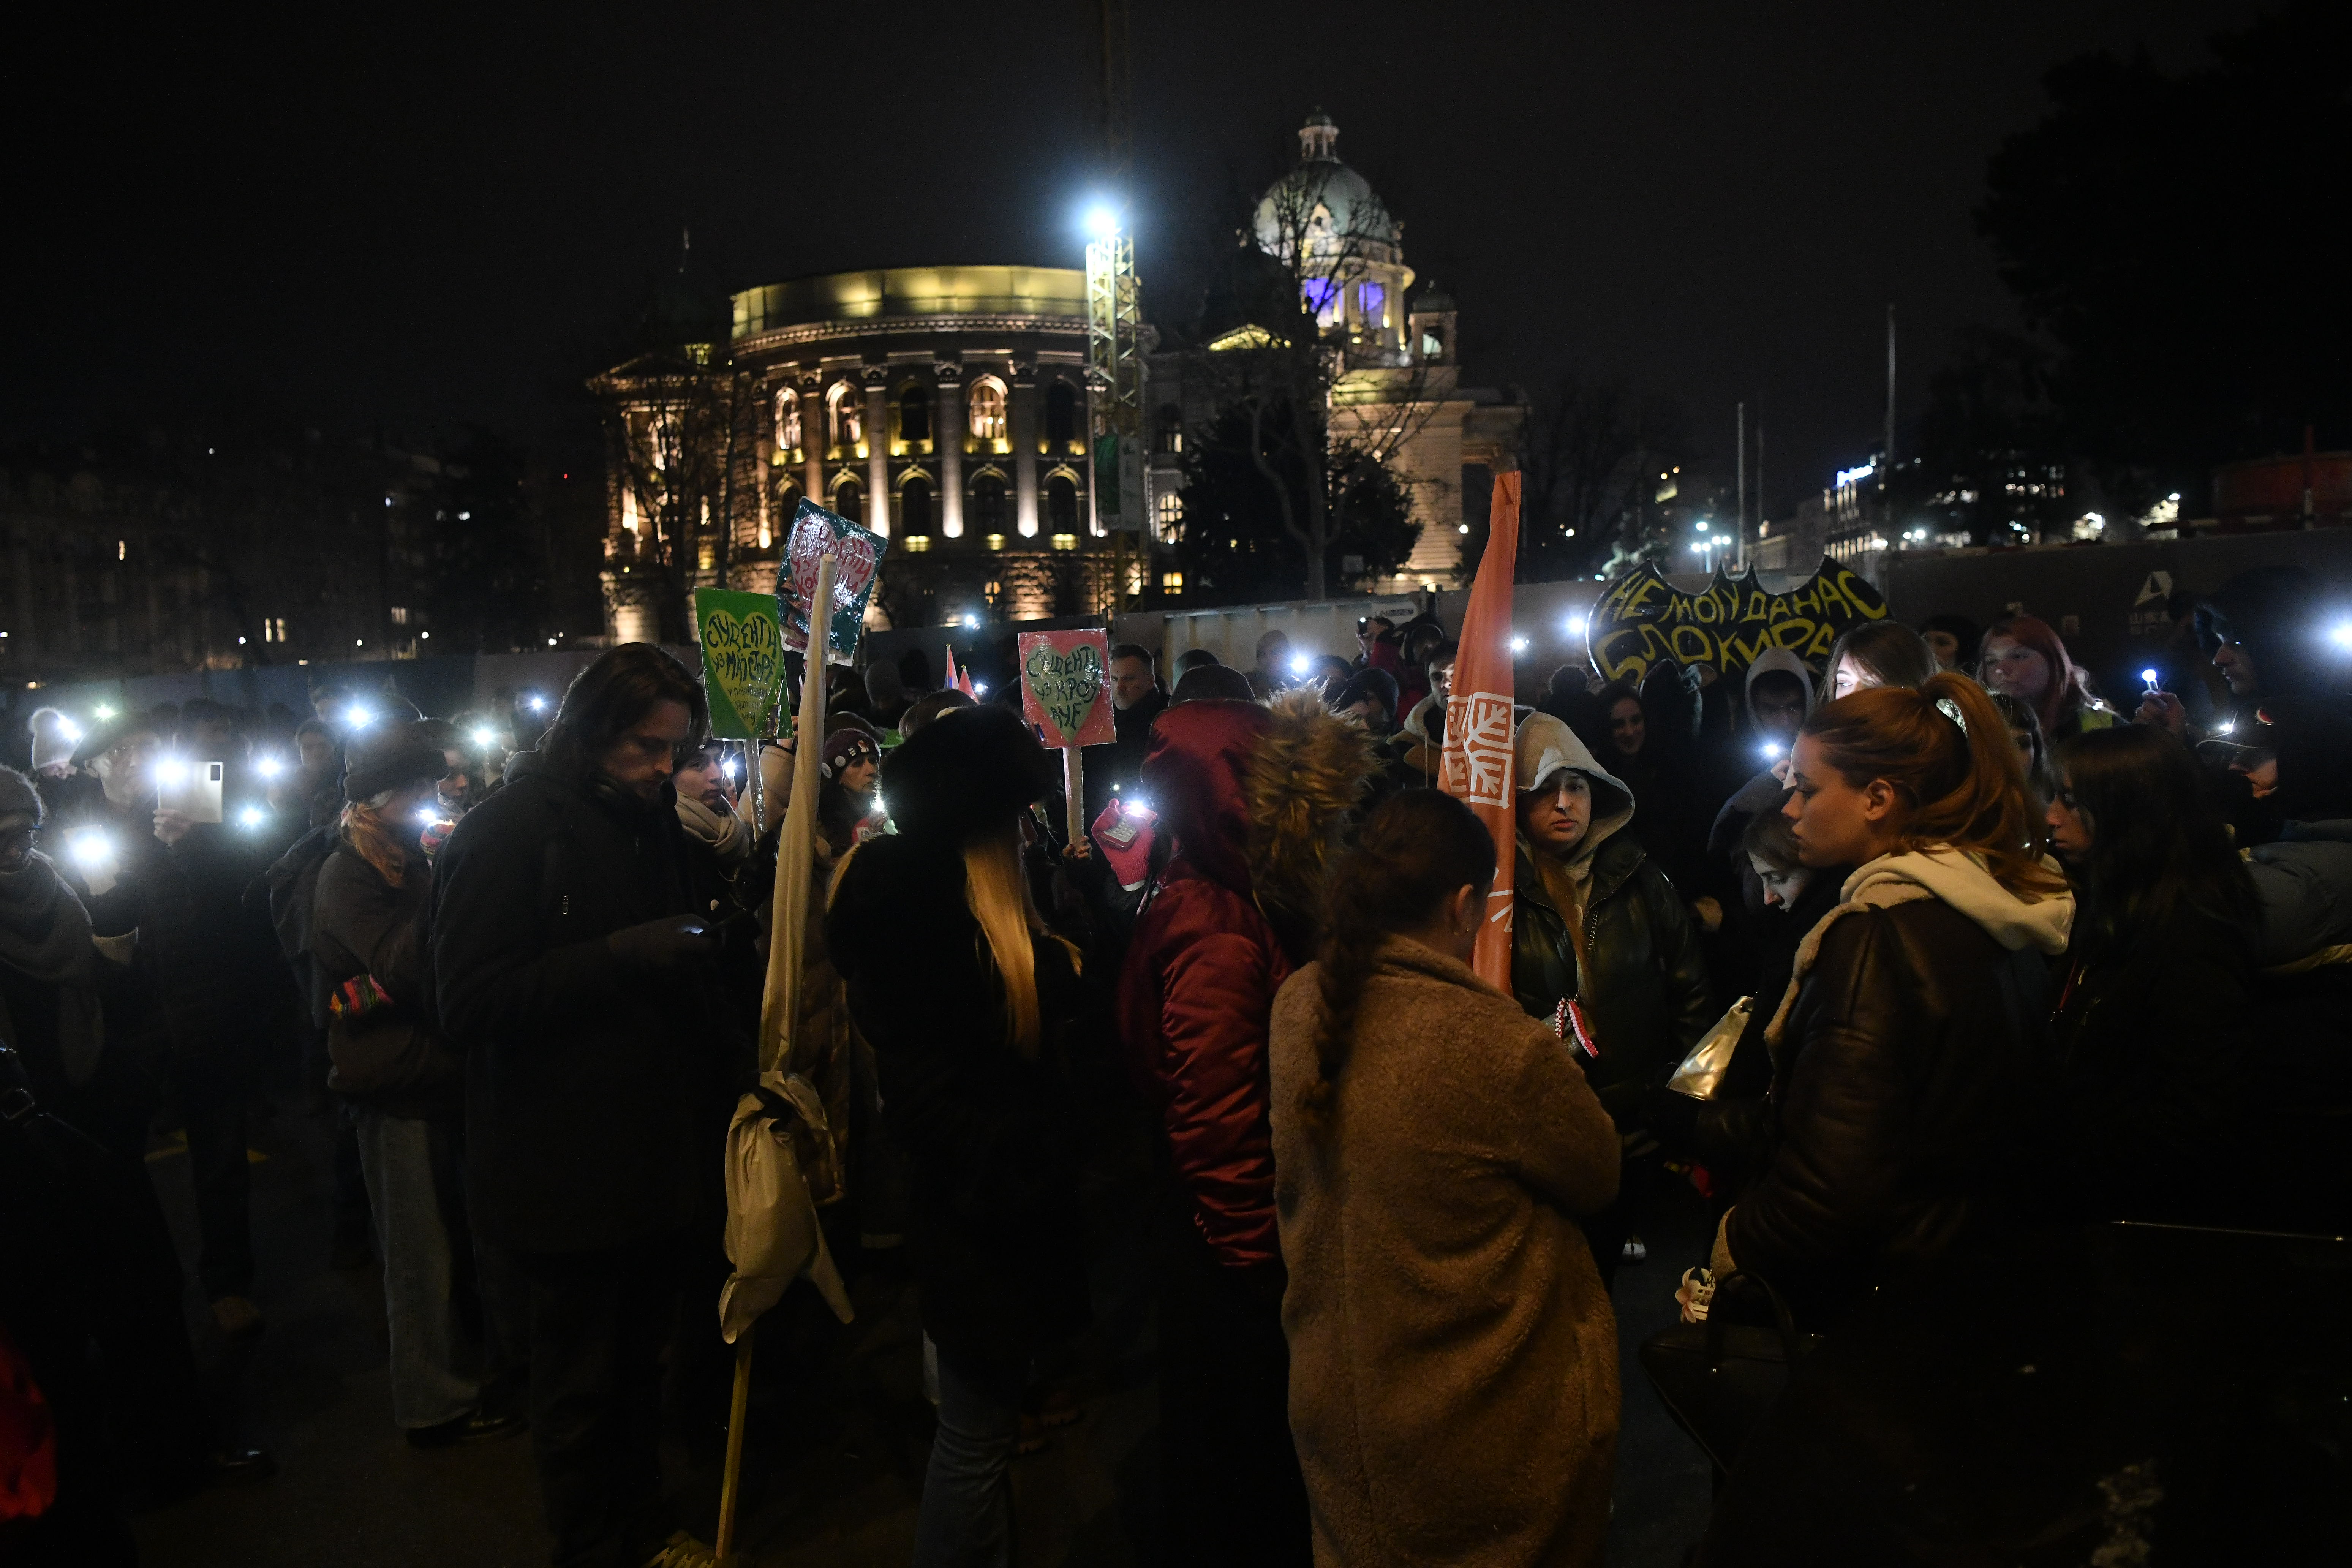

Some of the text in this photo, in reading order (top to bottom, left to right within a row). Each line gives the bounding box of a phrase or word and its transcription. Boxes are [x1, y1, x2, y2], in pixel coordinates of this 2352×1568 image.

[1598, 571, 1665, 628] НЕ
[707, 613, 777, 659] СТУДЕНТИ
[1596, 617, 1834, 687] БЛОКИРА
[712, 653, 725, 673] УЗ
